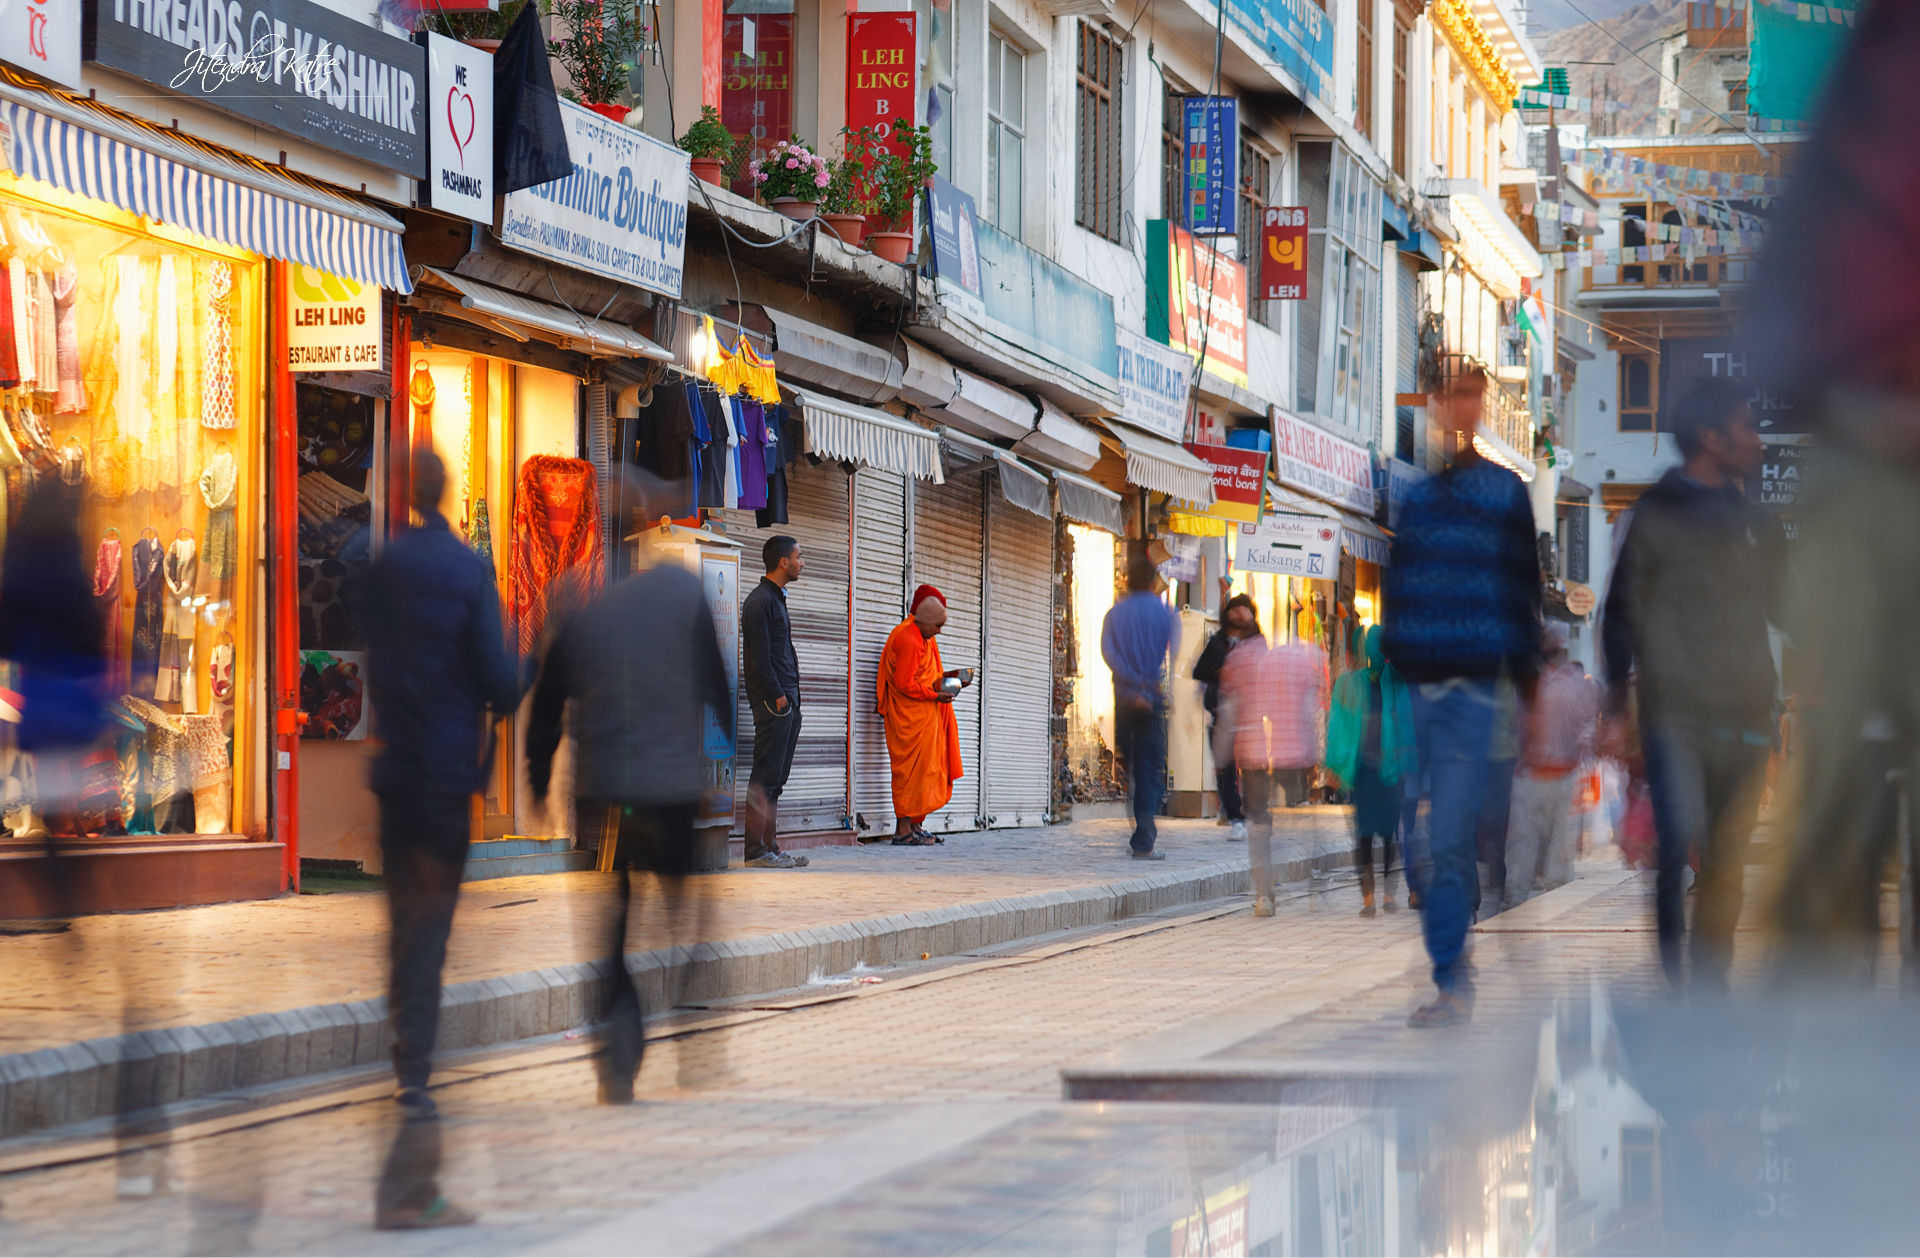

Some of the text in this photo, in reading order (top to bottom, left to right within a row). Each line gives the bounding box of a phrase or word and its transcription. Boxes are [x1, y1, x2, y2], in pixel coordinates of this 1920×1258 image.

[862, 48, 904, 65] LEH
[113, 0, 244, 66] READS
[294, 27, 417, 136] KASHMIR
[455, 64, 467, 87] WE
[856, 72, 909, 89] LING
[442, 168, 482, 199] PASHMINAS
[614, 166, 686, 260] Boutique
[1265, 209, 1305, 227] PNB
[539, 221, 570, 253] PASHMINA
[571, 232, 596, 260] SHAWLS
[596, 241, 611, 265] SILK
[611, 247, 641, 276] CARPETS
[646, 258, 657, 281] OLD
[658, 262, 681, 290] CARPETS
[1269, 285, 1300, 298] LEH
[295, 307, 365, 327] LEH LING
[288, 345, 377, 364] ESTAURANT & CAFE
[1703, 352, 1747, 376] TH
[1762, 464, 1799, 480] HA
[1212, 475, 1258, 491] onal bank
[1248, 548, 1303, 571] Kalsang
[713, 618, 734, 635] STIVAL
